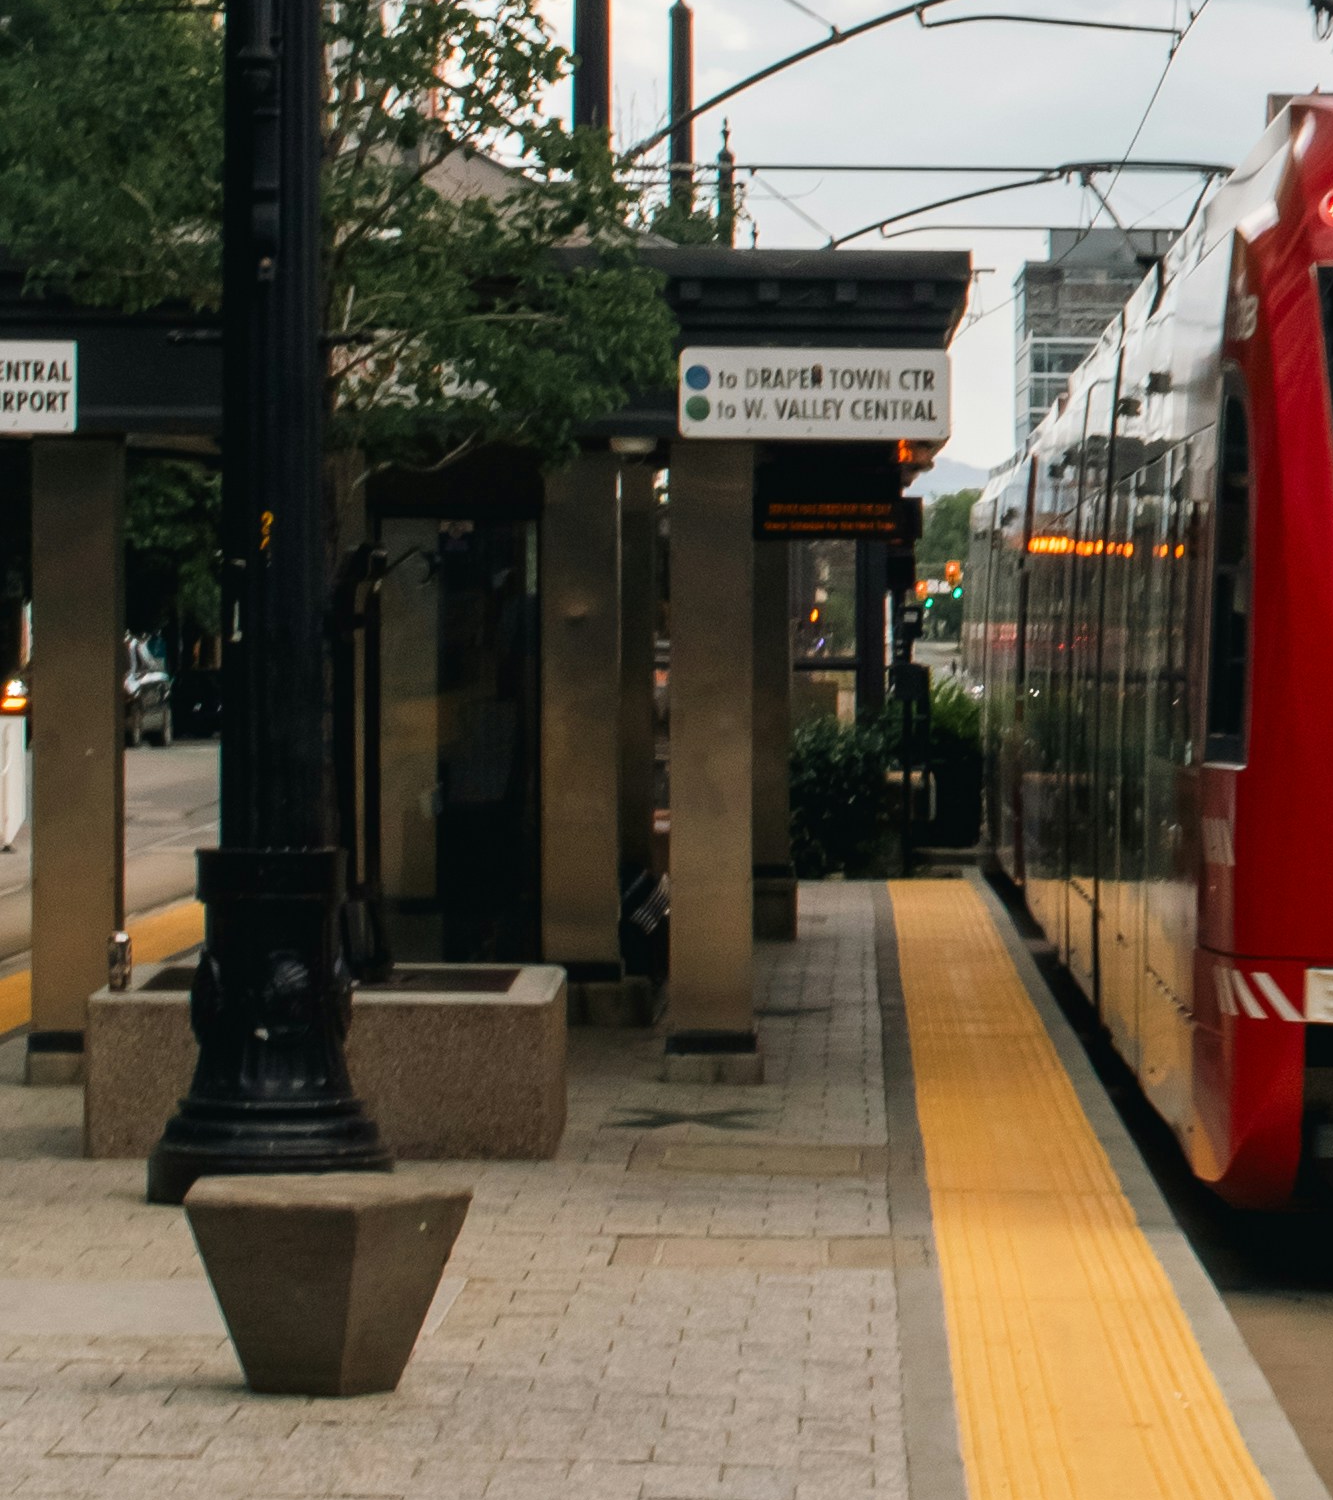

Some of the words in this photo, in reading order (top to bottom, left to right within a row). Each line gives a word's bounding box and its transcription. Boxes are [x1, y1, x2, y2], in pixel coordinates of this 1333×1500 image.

[718, 370, 738, 389] to
[745, 366, 822, 390] DRAPER
[829, 369, 891, 389] TOWN
[899, 369, 936, 390] CTR
[717, 399, 737, 420] to
[744, 398, 768, 420] W.
[775, 398, 844, 421] VALLEY
[850, 400, 937, 422] CENTRAL
